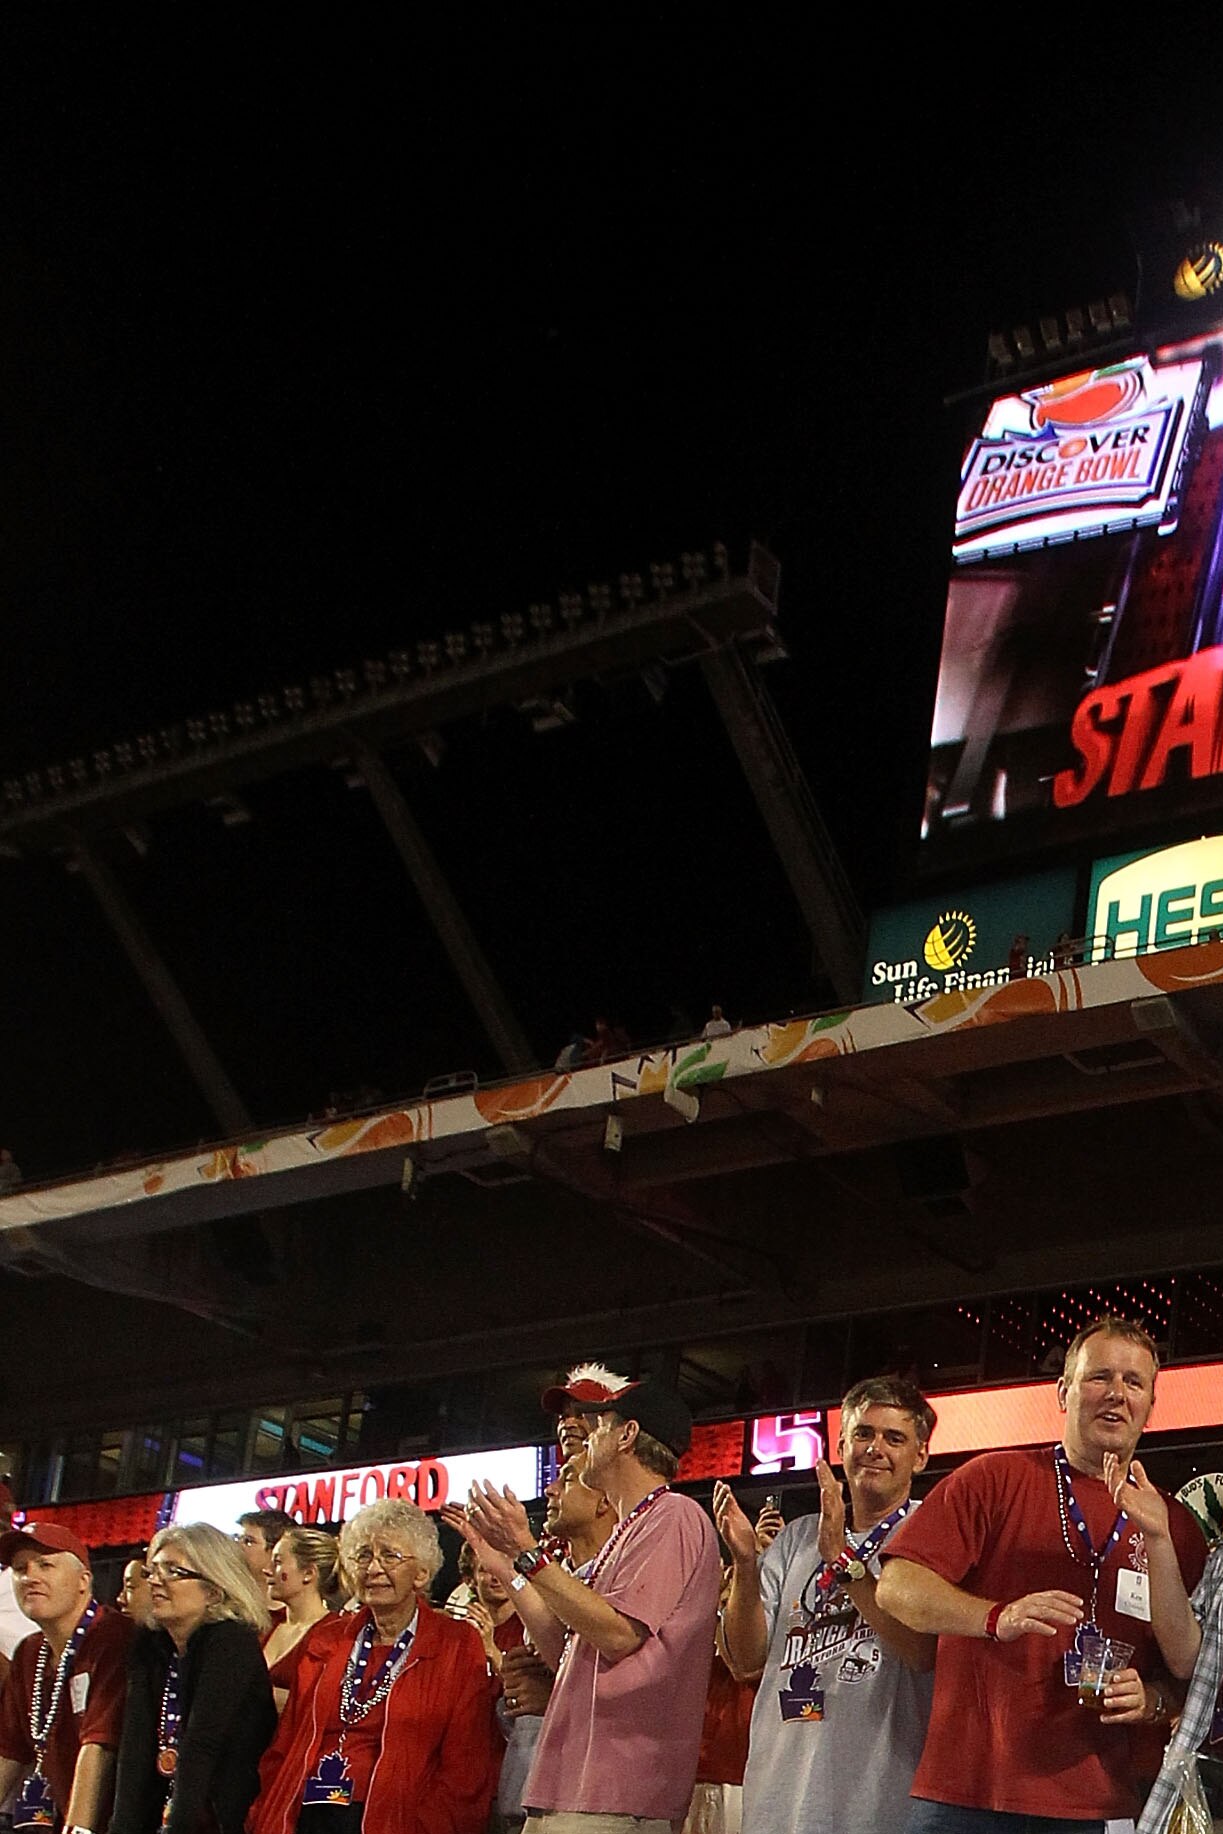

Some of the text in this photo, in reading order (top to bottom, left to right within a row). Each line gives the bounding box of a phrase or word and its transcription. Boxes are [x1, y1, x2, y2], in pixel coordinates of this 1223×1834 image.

[980, 424, 1151, 476] DISCOVER
[964, 447, 1140, 512] ORANGE BOWL
[871, 959, 918, 985] Sun
[943, 951, 1055, 994] Finanial
[254, 1456, 449, 1524] STANFORD
